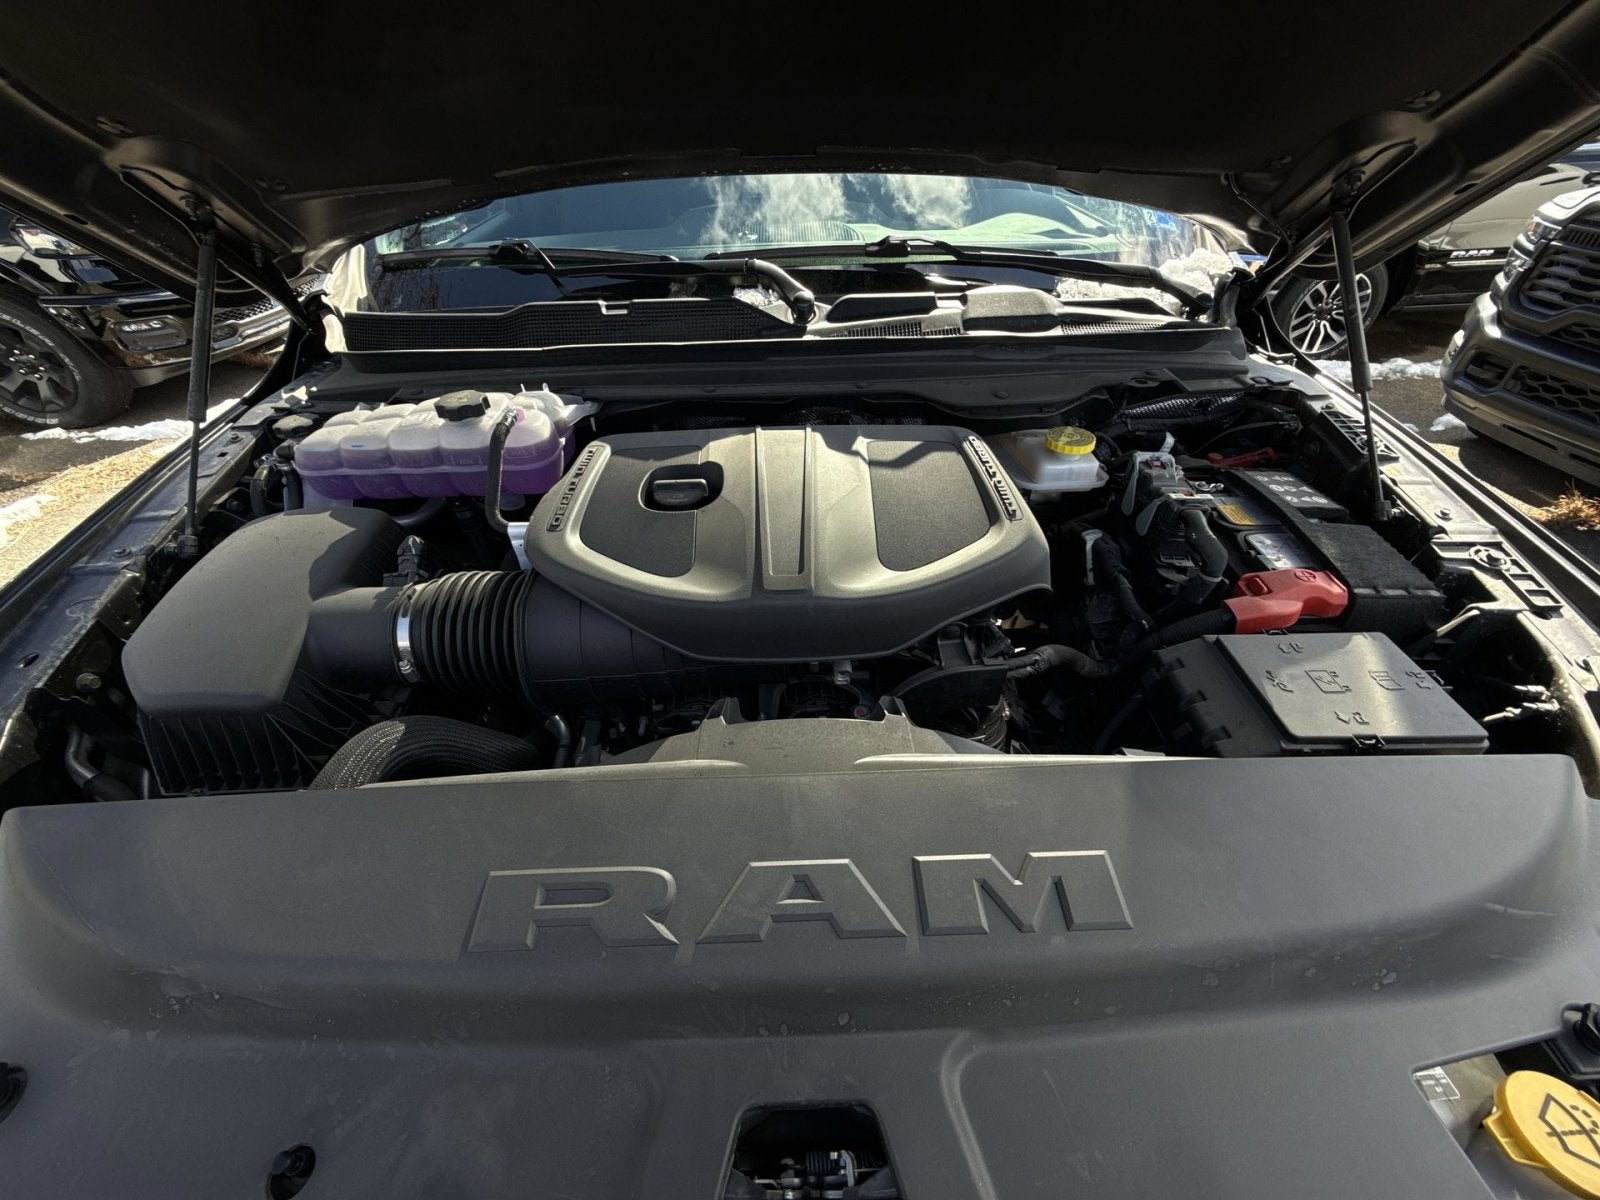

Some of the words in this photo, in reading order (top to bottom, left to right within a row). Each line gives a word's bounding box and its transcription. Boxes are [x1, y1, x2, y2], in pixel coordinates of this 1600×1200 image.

[1450, 250, 1494, 258] RAM
[573, 447, 598, 479] TWIN
[967, 436, 995, 475] TURBO
[551, 477, 582, 527] TURBO
[991, 477, 1016, 515] TWIN
[463, 850, 1134, 953] RAM
